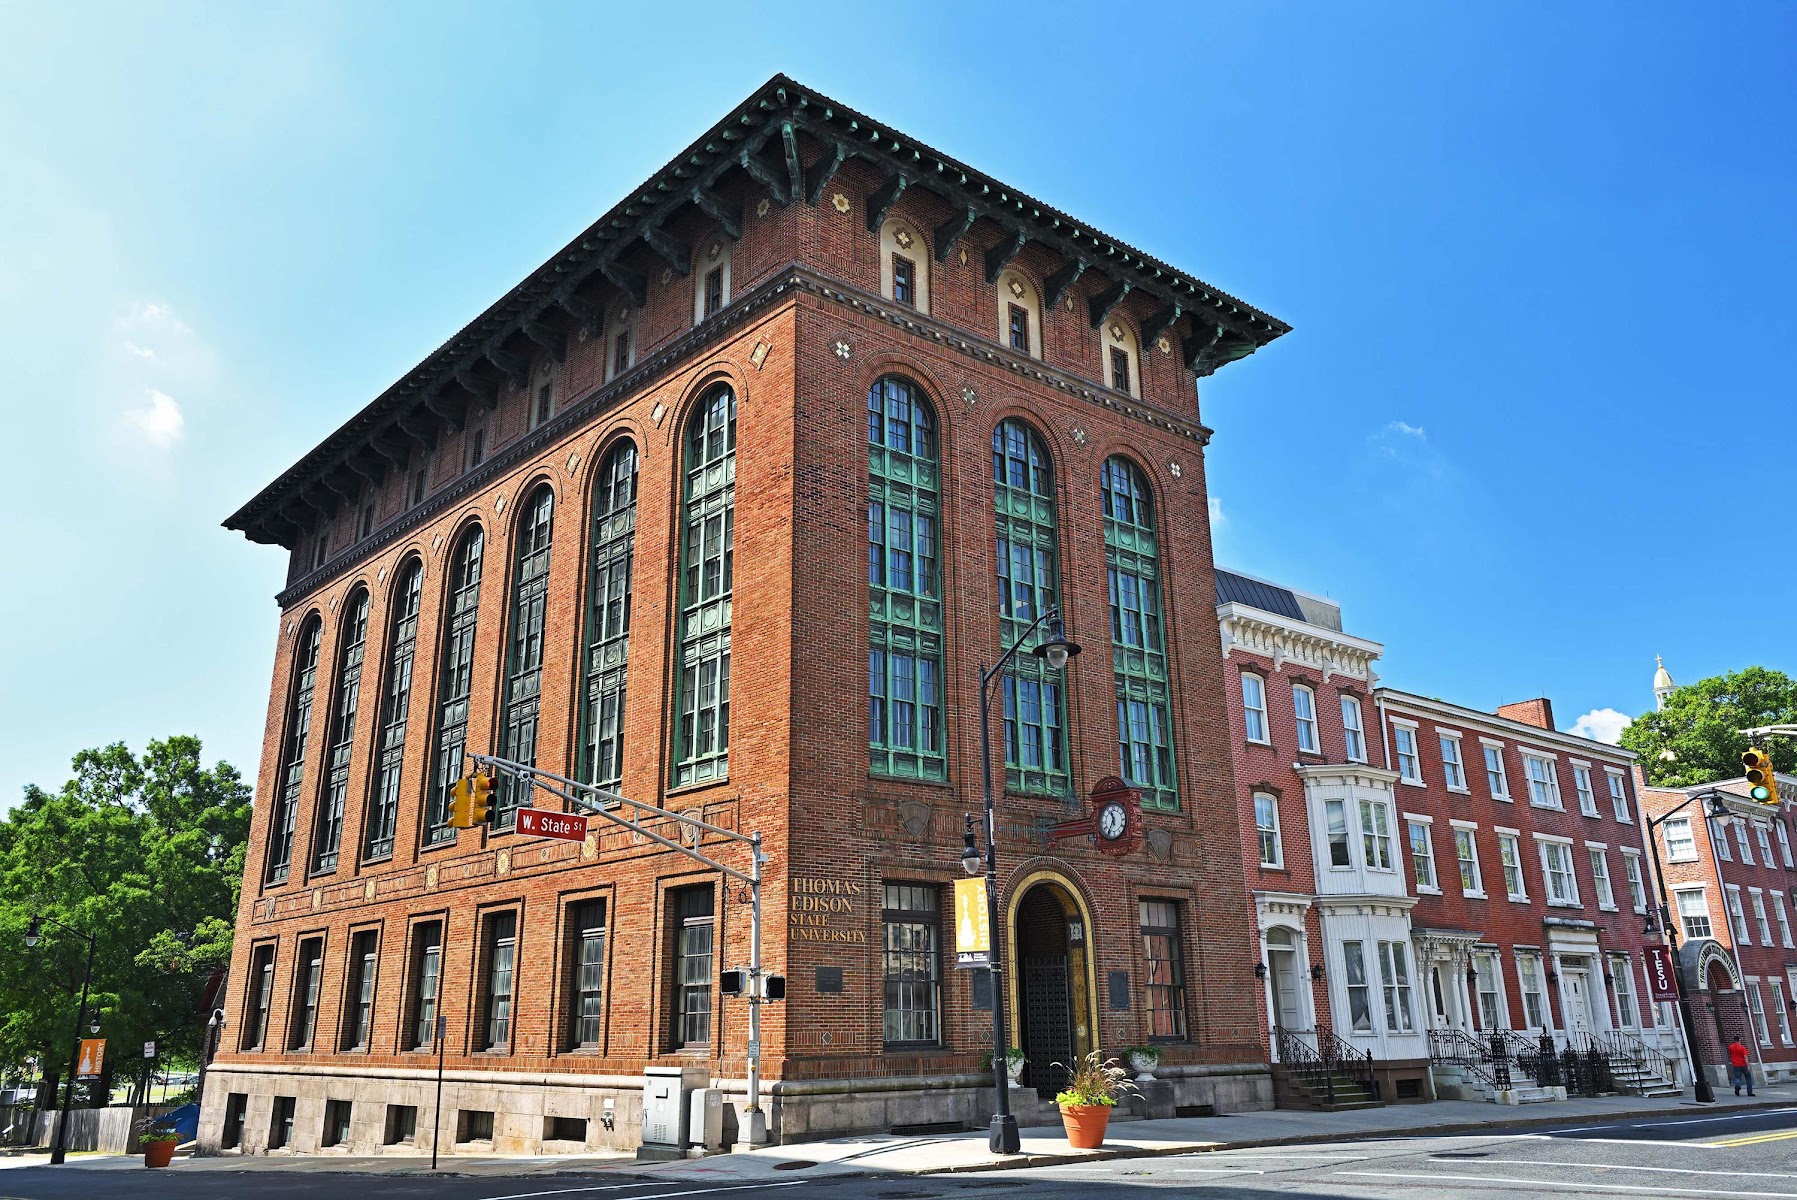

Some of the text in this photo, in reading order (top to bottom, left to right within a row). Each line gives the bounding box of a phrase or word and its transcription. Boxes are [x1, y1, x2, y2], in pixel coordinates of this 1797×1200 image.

[523, 815, 582, 834] W. State St
[791, 877, 860, 896] THOMAS
[791, 896, 853, 912] EDISON
[790, 913, 830, 927] STATE
[976, 884, 988, 948] HISTORY
[790, 928, 867, 943] UNIVERSITY
[1652, 950, 1668, 990] TESU
[94, 1042, 104, 1073] HISTORY
